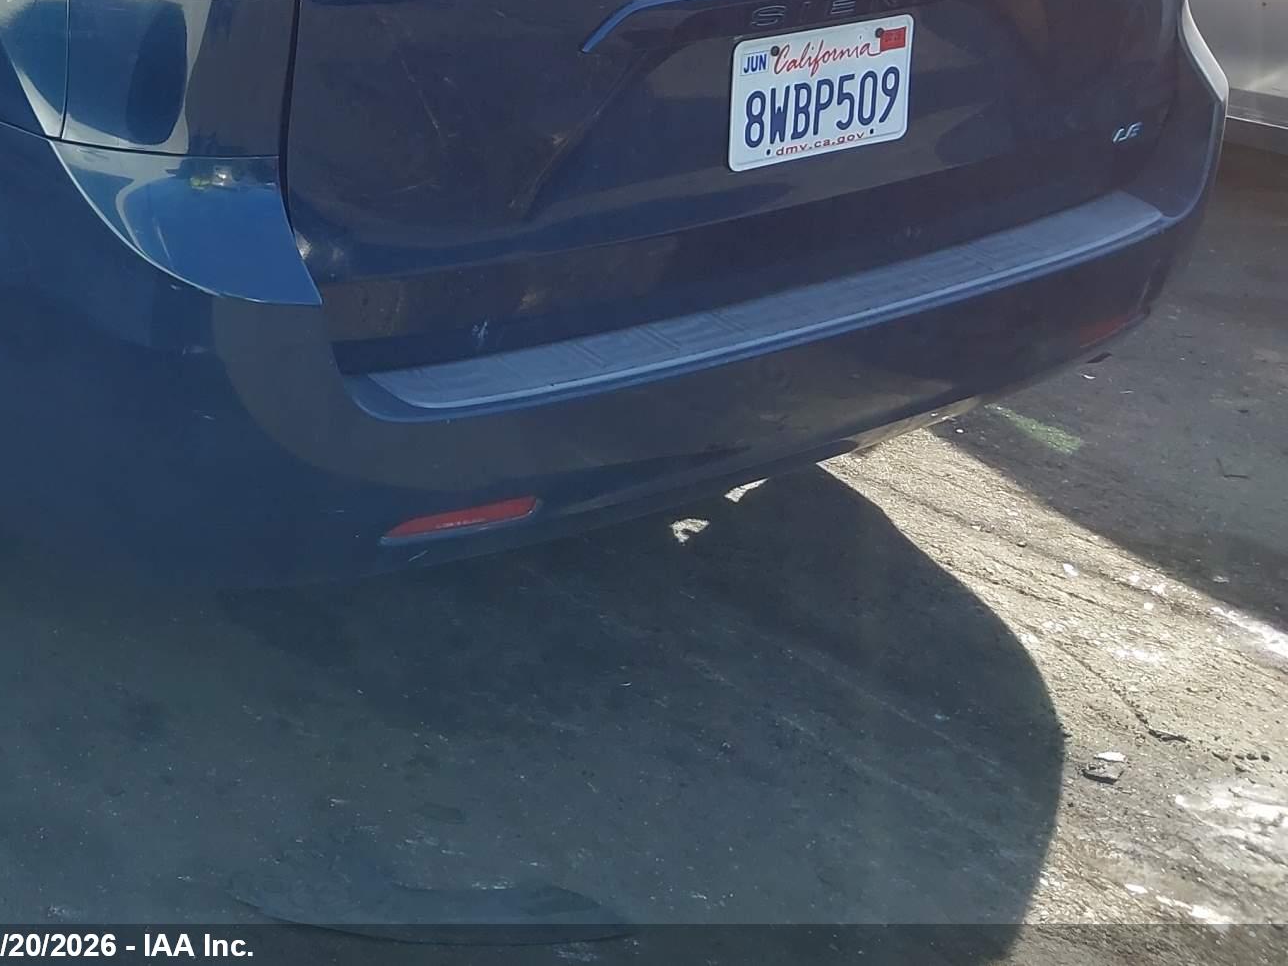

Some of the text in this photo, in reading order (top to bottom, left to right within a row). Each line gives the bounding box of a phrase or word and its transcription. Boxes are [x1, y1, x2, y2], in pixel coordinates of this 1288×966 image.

[743, 53, 767, 73] JUN
[773, 37, 880, 77] California
[744, 66, 900, 148] 8WBP509
[775, 132, 865, 156] dmv.ca.gov
